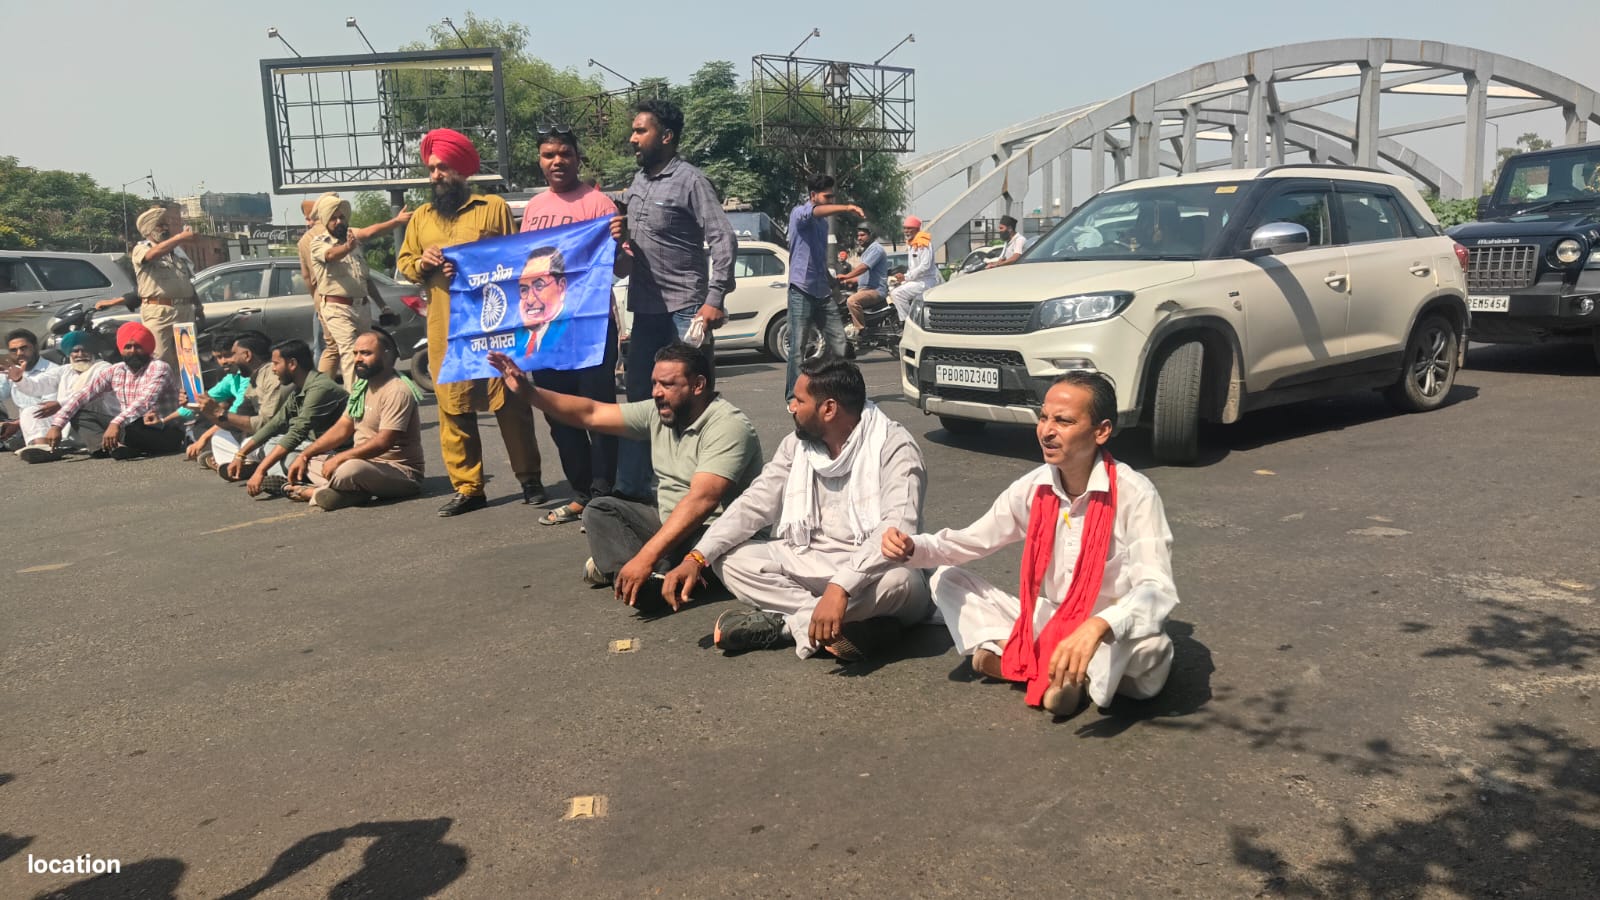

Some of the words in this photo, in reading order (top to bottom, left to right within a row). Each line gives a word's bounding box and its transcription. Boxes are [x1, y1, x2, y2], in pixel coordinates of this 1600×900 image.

[468, 272, 490, 287] जय
[491, 264, 513, 282] भीम
[471, 338, 488, 352] जय
[489, 333, 515, 349] भारत
[942, 367, 998, 385] PB08DZ3409
